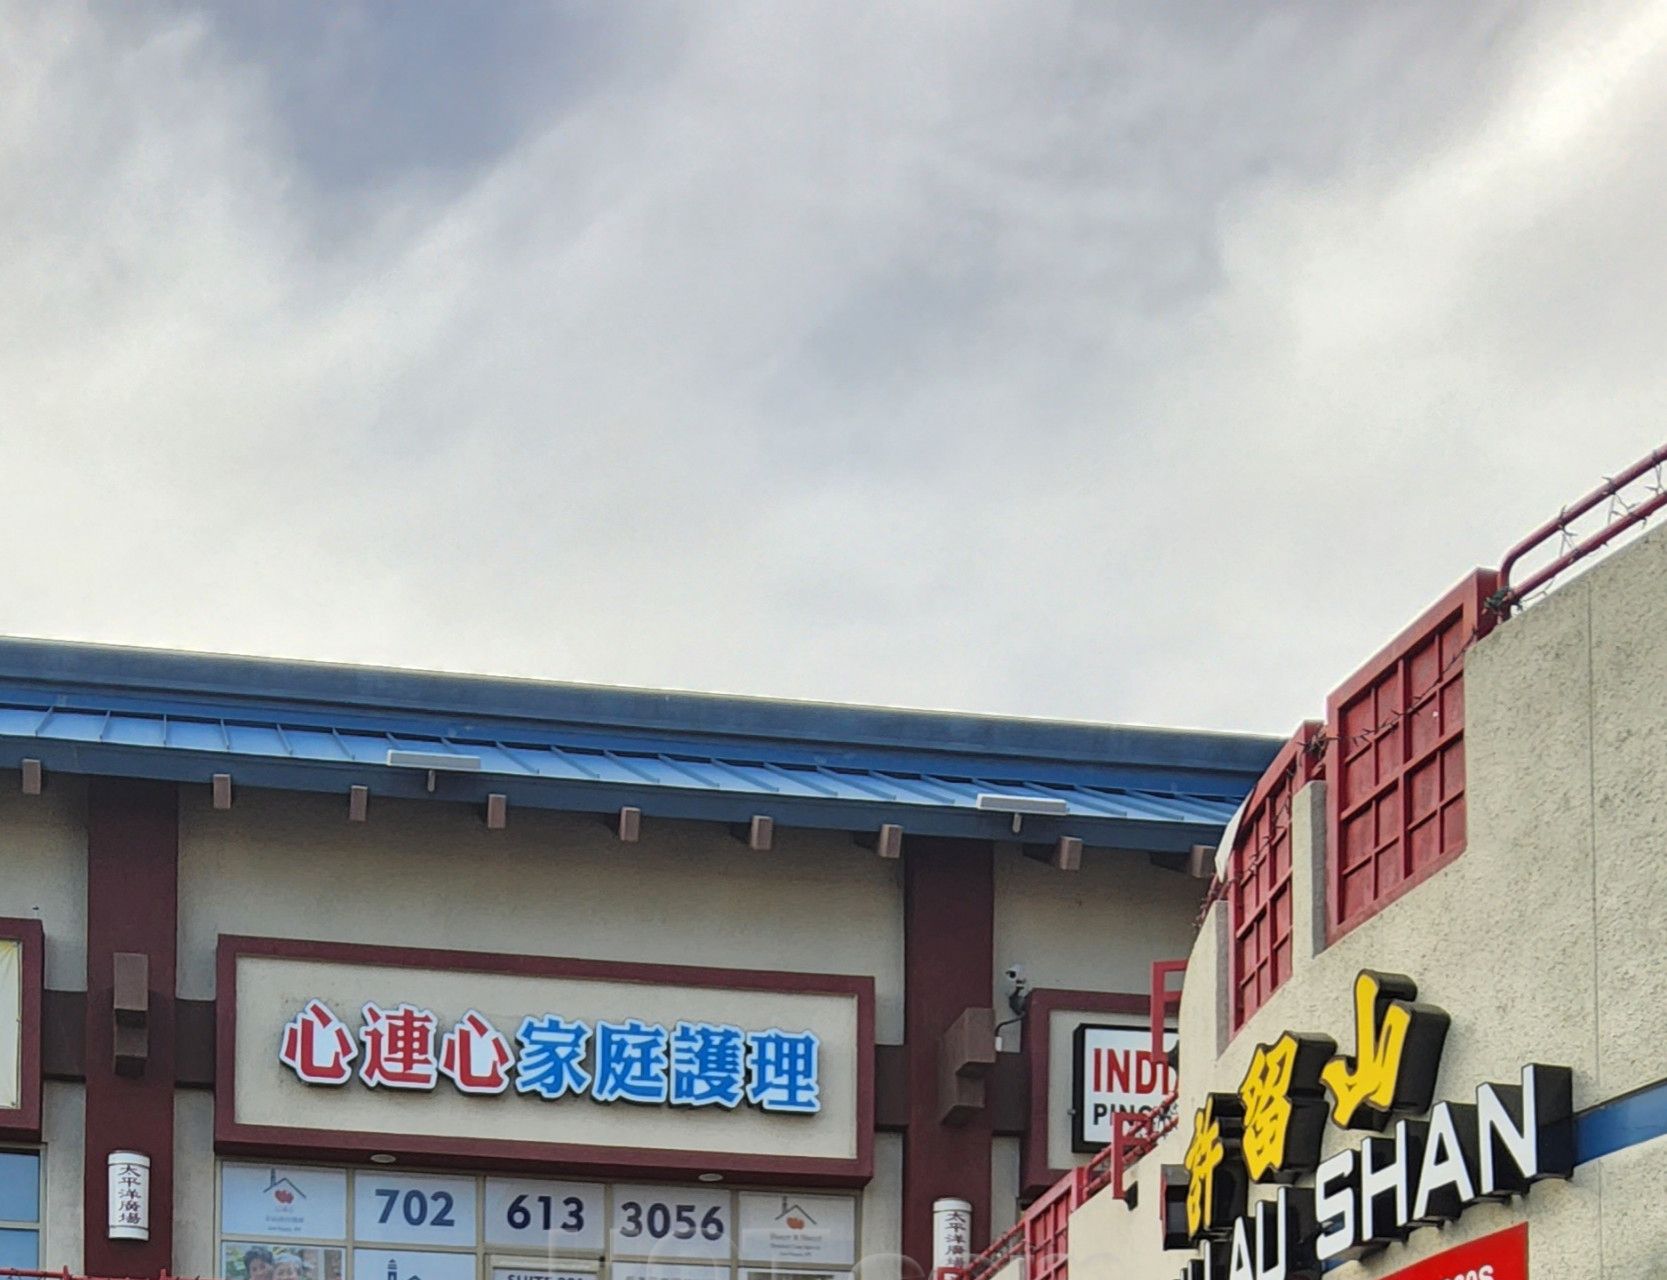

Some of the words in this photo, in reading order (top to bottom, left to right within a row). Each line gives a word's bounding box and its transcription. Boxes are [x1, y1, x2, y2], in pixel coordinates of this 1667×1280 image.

[282, 1001, 821, 1111] 心連心家庭護理
[1316, 1063, 1538, 1260] SHAN
[374, 1188, 455, 1227] 702
[507, 1194, 584, 1232] 613
[620, 1201, 724, 1240] 3056
